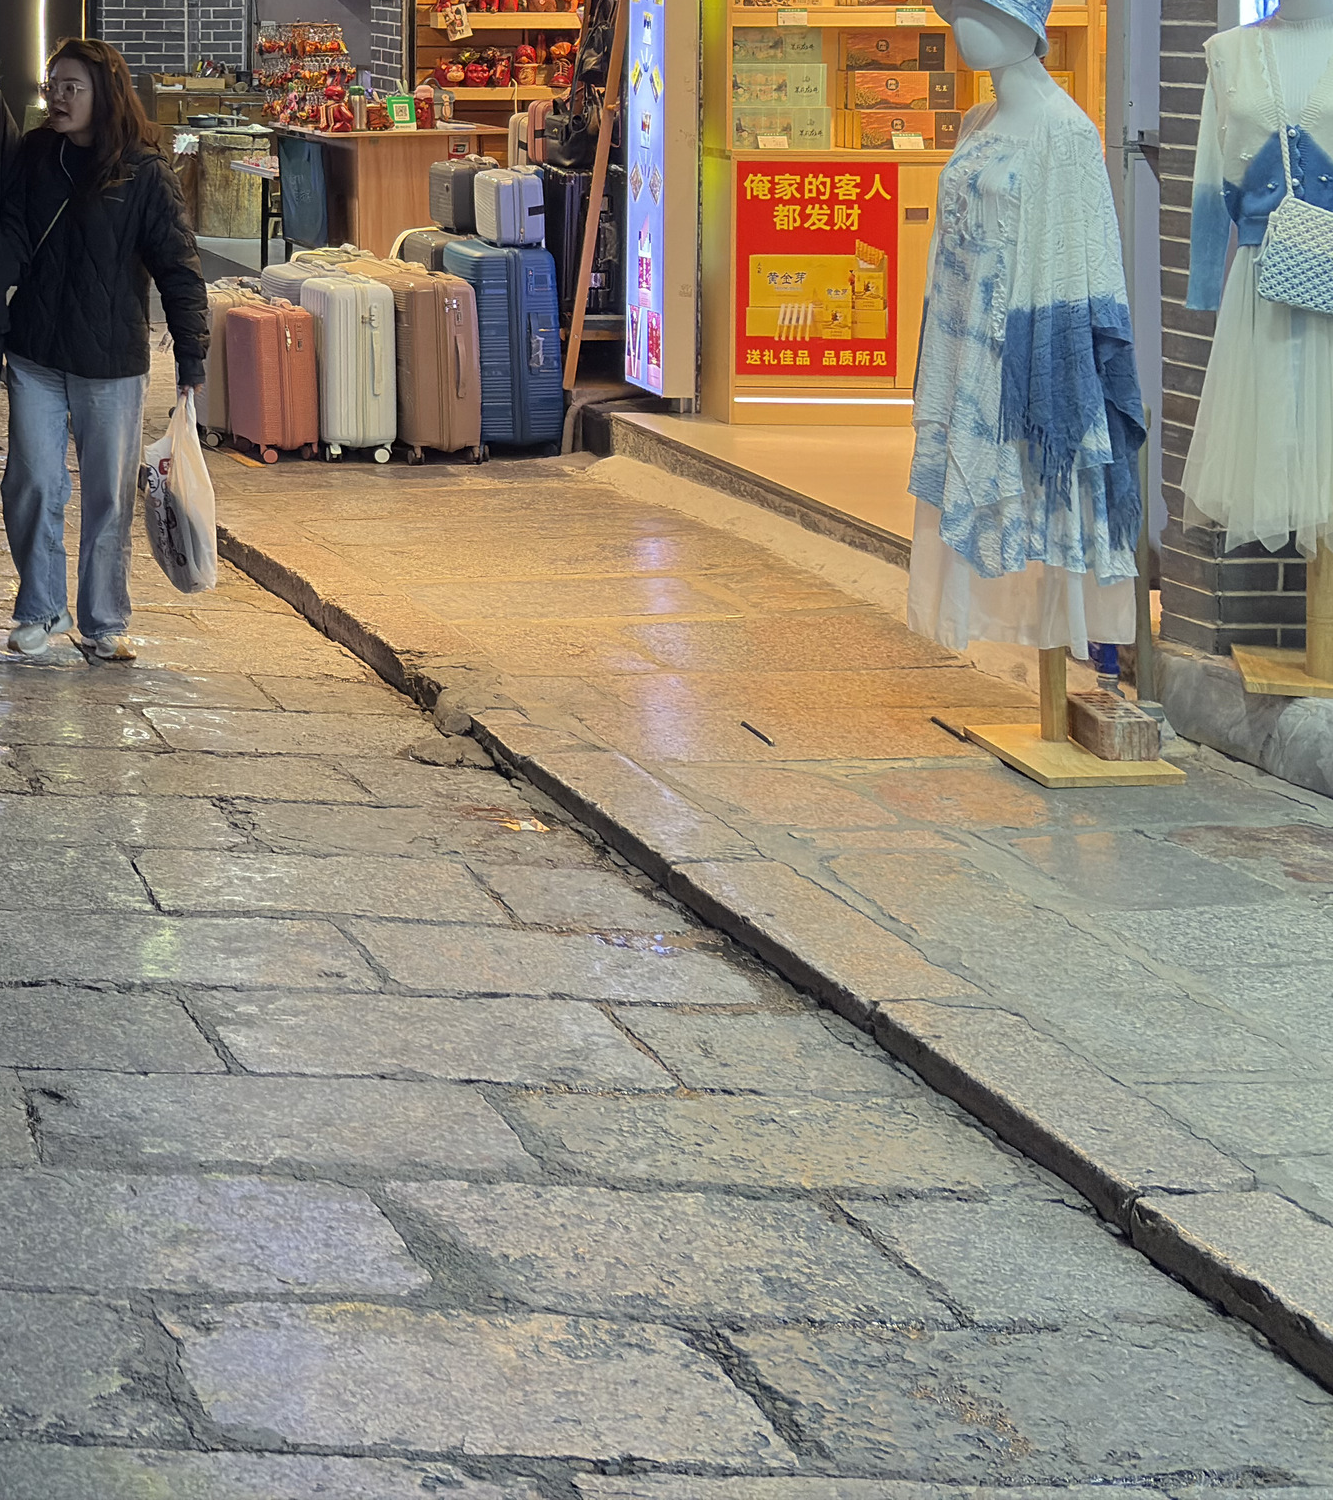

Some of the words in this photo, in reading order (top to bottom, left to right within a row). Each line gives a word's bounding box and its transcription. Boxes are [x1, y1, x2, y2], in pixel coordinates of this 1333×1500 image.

[743, 173, 892, 201] 俺家的客人
[773, 204, 862, 231] 都发财
[767, 271, 807, 285] 黄金芽
[745, 349, 811, 366] 送礼佳品
[822, 350, 888, 367] 品质所见
